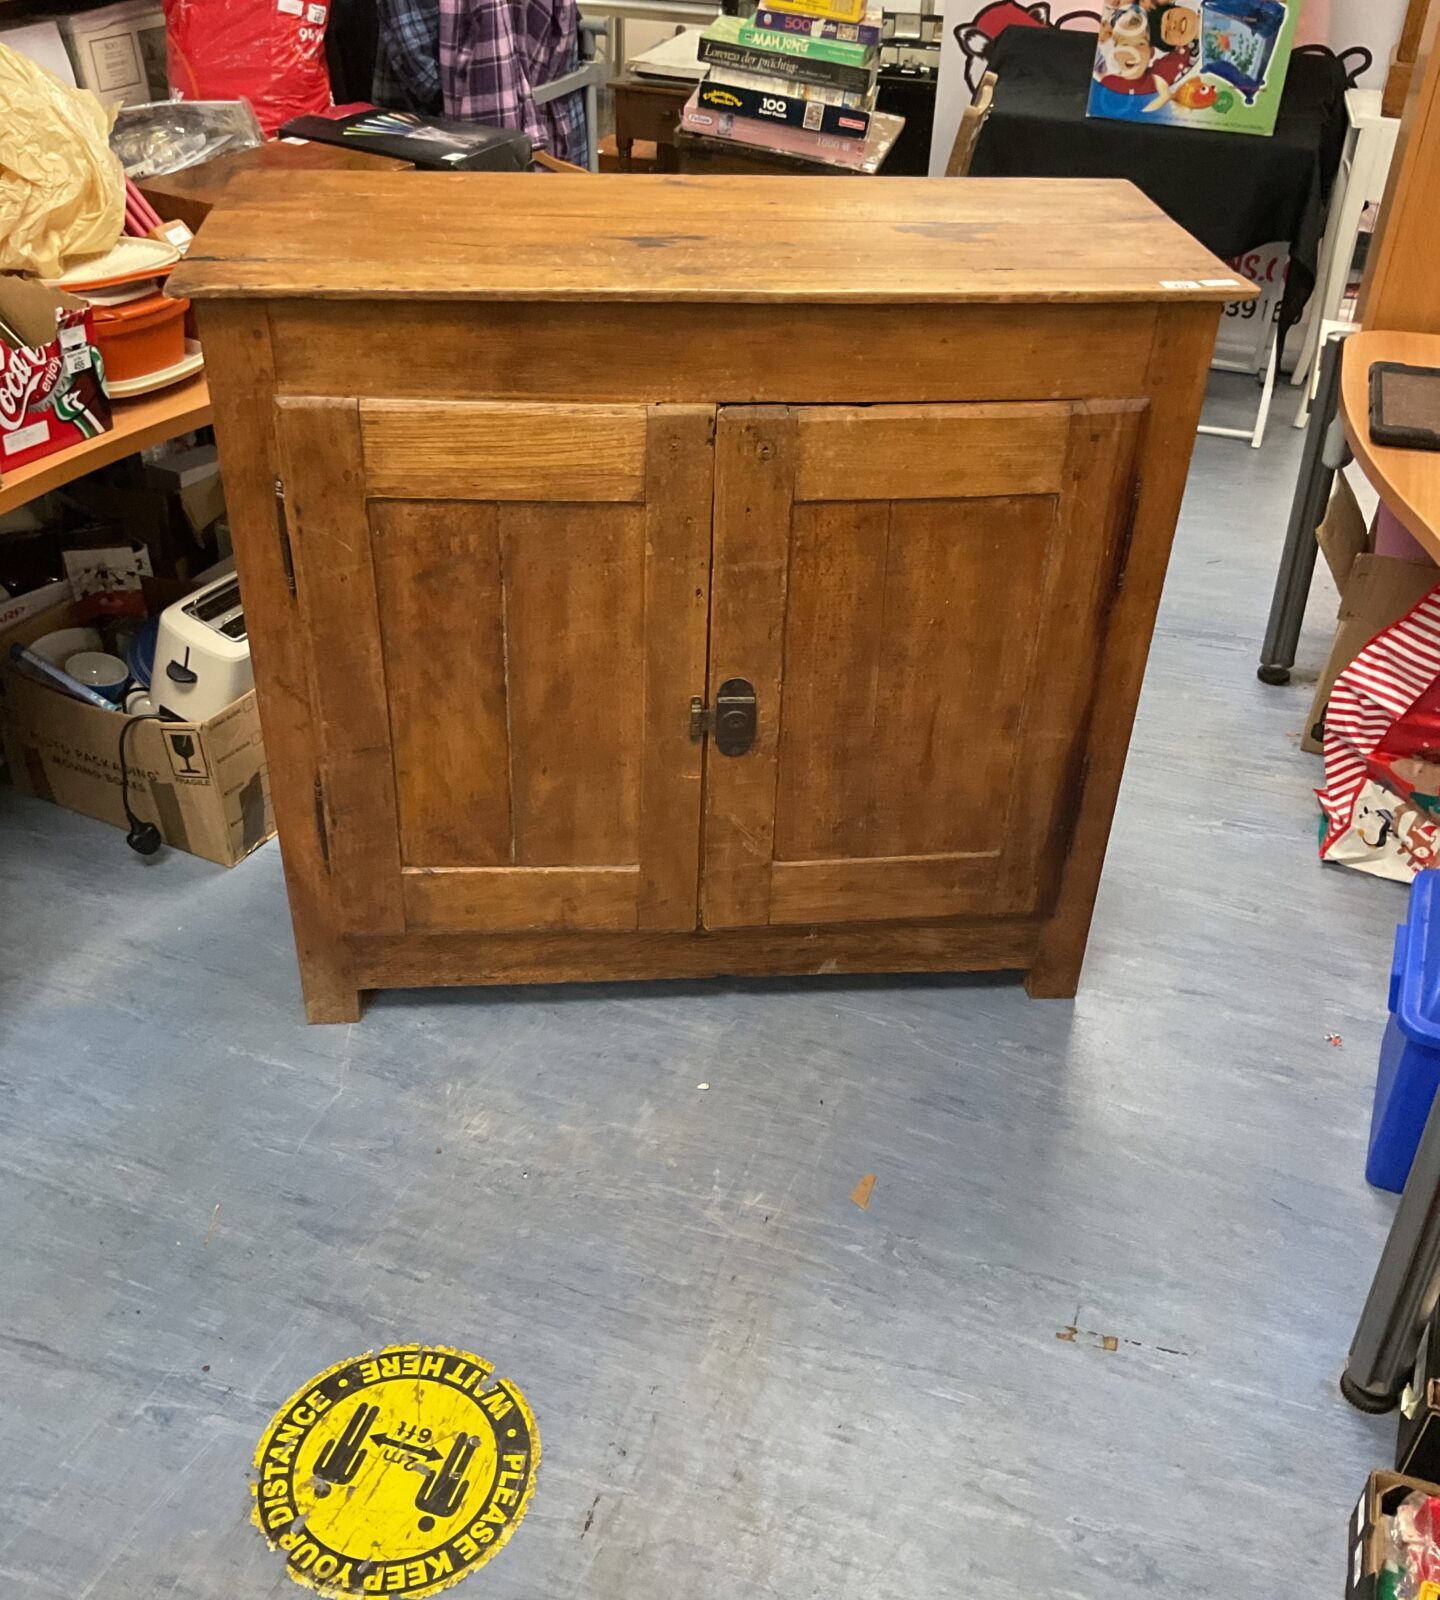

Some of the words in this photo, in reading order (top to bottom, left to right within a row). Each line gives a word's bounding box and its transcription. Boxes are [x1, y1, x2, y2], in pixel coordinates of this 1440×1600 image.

[784, 16, 812, 32] 500
[704, 43, 740, 61] Lorenzo
[741, 51, 758, 65] der
[762, 97, 787, 113] 100
[42, 356, 62, 393] enjoy
[175, 777, 210, 786] FRAGILE
[359, 1354, 446, 1385] HERE
[396, 1420, 433, 1444] 6ft
[262, 1389, 333, 1530] DISTANCE
[383, 1449, 419, 1472] 2m
[453, 1453, 526, 1562] PLEASE
[278, 1533, 353, 1589] YOUR
[362, 1550, 454, 1592] KEEP
